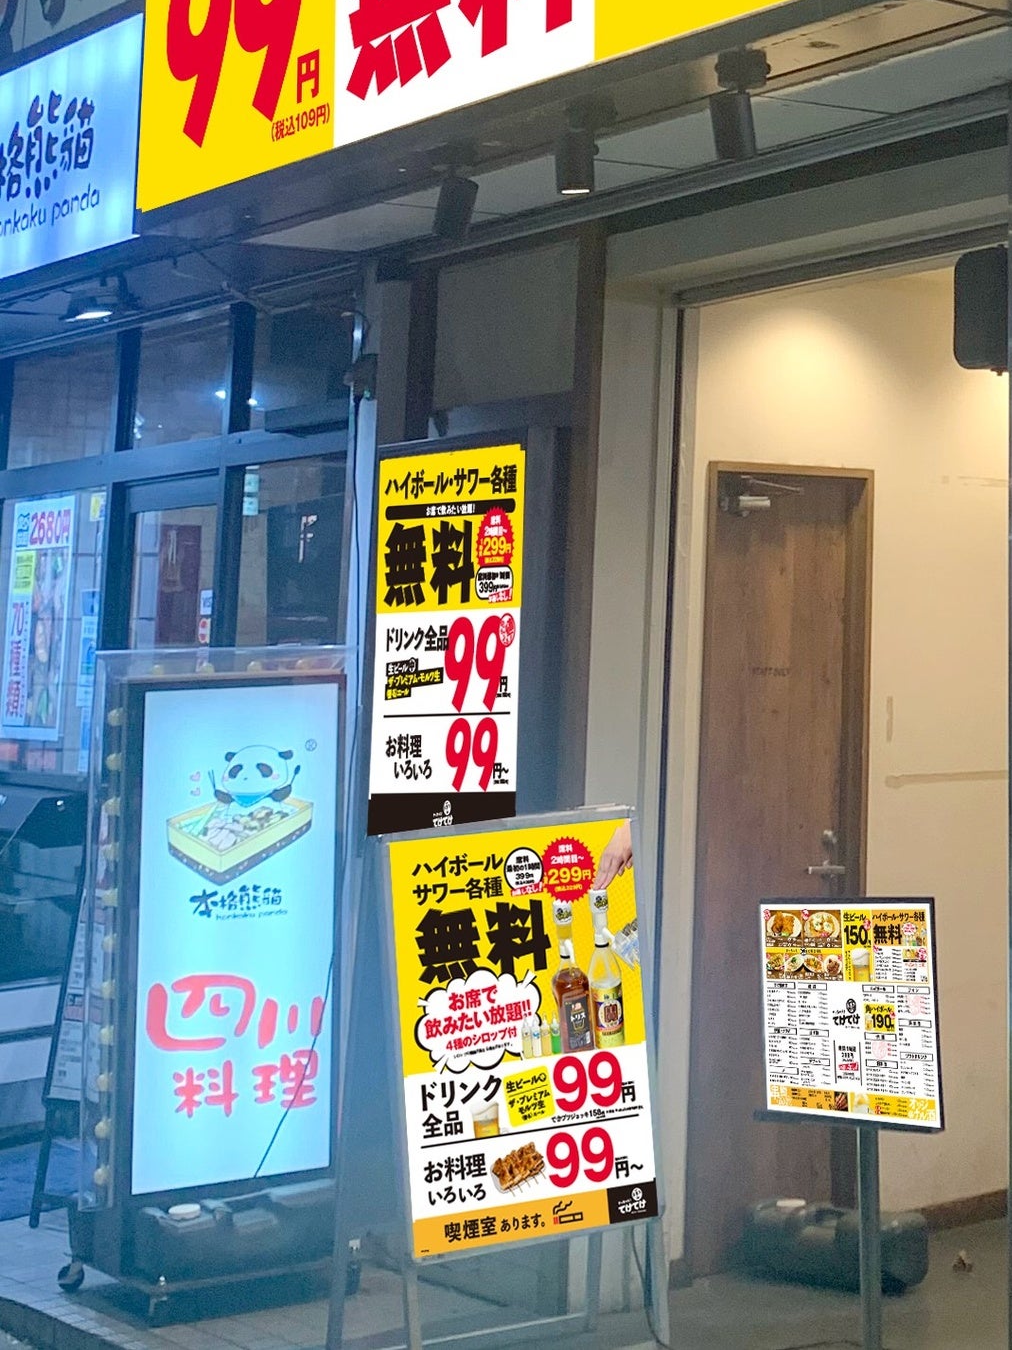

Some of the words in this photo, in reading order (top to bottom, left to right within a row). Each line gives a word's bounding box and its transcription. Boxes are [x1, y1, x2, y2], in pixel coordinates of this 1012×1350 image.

[0, 202, 47, 238] nkaku
[51, 182, 101, 227] panda
[384, 464, 517, 499] ハイボール・サワー各種
[384, 519, 476, 607] 無料
[386, 625, 450, 652] ドリンク全品
[385, 733, 422, 759] お料理
[394, 759, 433, 780] いろいろ
[412, 852, 503, 879] ハイボール
[412, 877, 503, 905] サワー各種
[414, 899, 551, 985] 無料
[873, 924, 902, 944] 無料
[448, 984, 498, 1011] お席で
[424, 999, 532, 1040] 飲みたい放題!!
[832, 1013, 860, 1026] てけてけ
[445, 1026, 517, 1051] 4種のシロップ付
[420, 1074, 502, 1113] ドリンク
[422, 1111, 464, 1140] 全品
[424, 1153, 487, 1184] お料理
[428, 1183, 487, 1206] いろいろ
[618, 1199, 647, 1214] てけてけ
